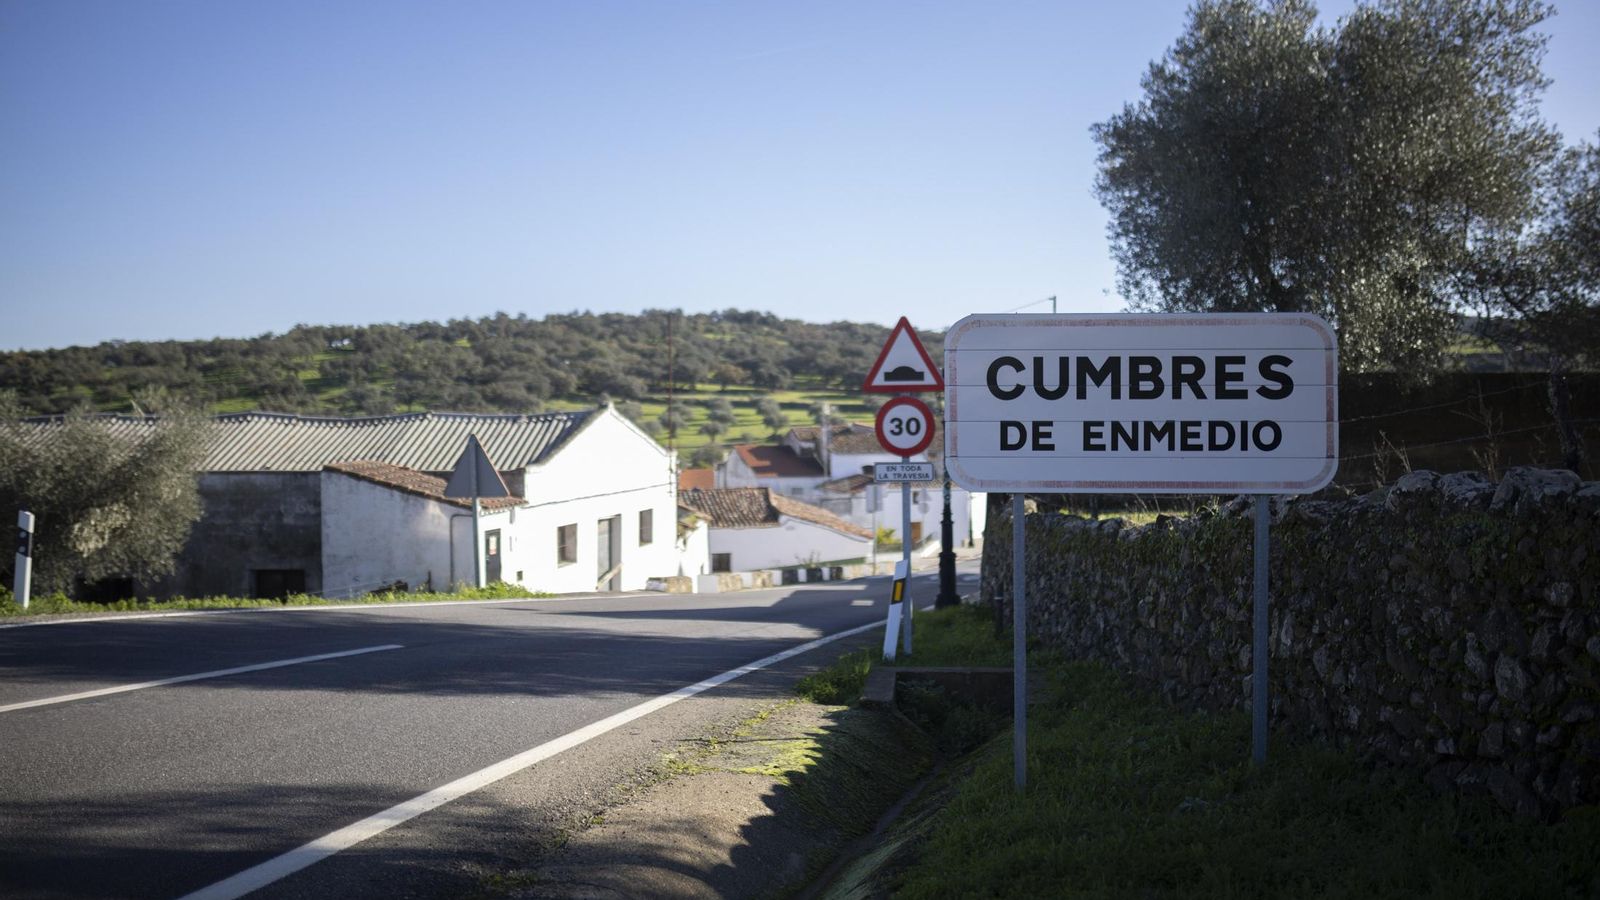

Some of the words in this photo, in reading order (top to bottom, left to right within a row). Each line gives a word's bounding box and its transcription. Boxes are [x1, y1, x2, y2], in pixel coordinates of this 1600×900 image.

[986, 354, 1294, 401] CUMBRES
[889, 417, 921, 436] 30
[1000, 420, 1055, 451] DE
[1083, 419, 1283, 452] ENMEDIO
